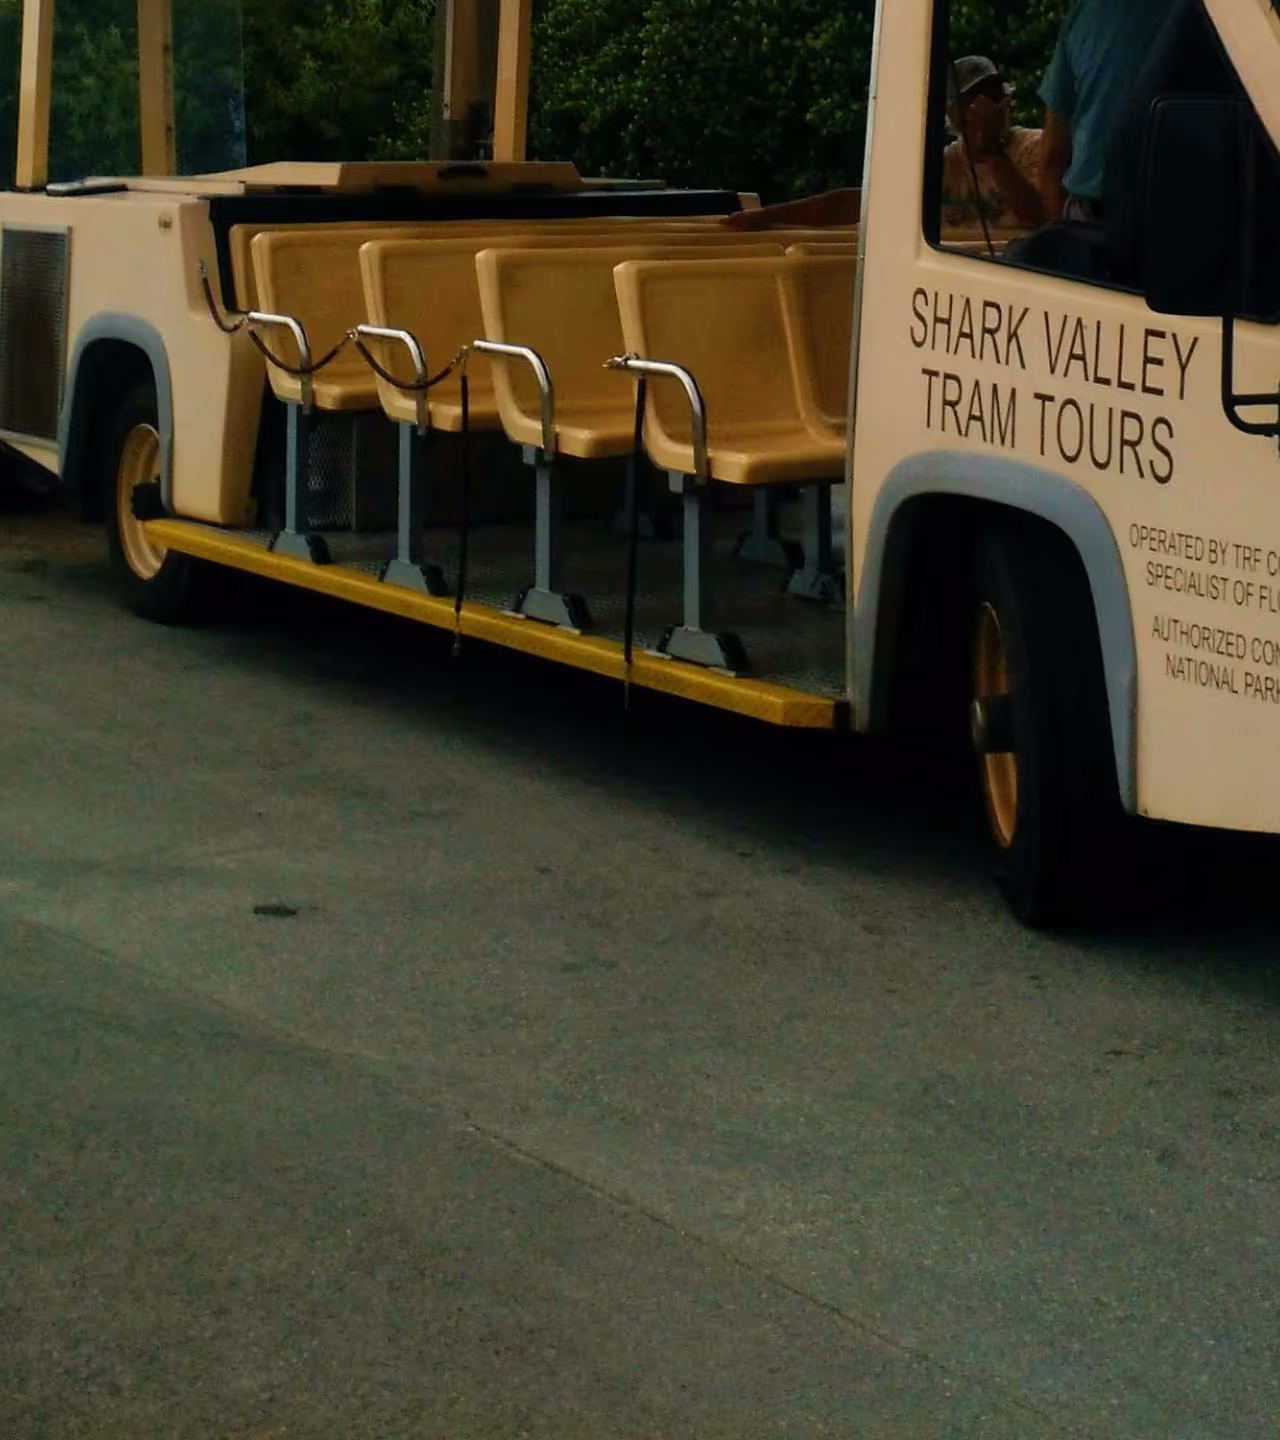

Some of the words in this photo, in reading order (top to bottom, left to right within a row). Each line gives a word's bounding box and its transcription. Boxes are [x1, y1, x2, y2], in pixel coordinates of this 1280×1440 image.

[910, 287, 1029, 370] SHARK
[1044, 311, 1199, 400] VALLEY
[922, 367, 1017, 448] TRAM
[1033, 392, 1174, 485] TOURS
[1129, 522, 1204, 561] OPERATED
[1208, 538, 1228, 566] BY
[1146, 560, 1229, 602] SPECIALIST
[1233, 580, 1254, 607] OF
[1151, 615, 1247, 660] AUTHORIZED
[1166, 652, 1239, 695] NATIONAL
